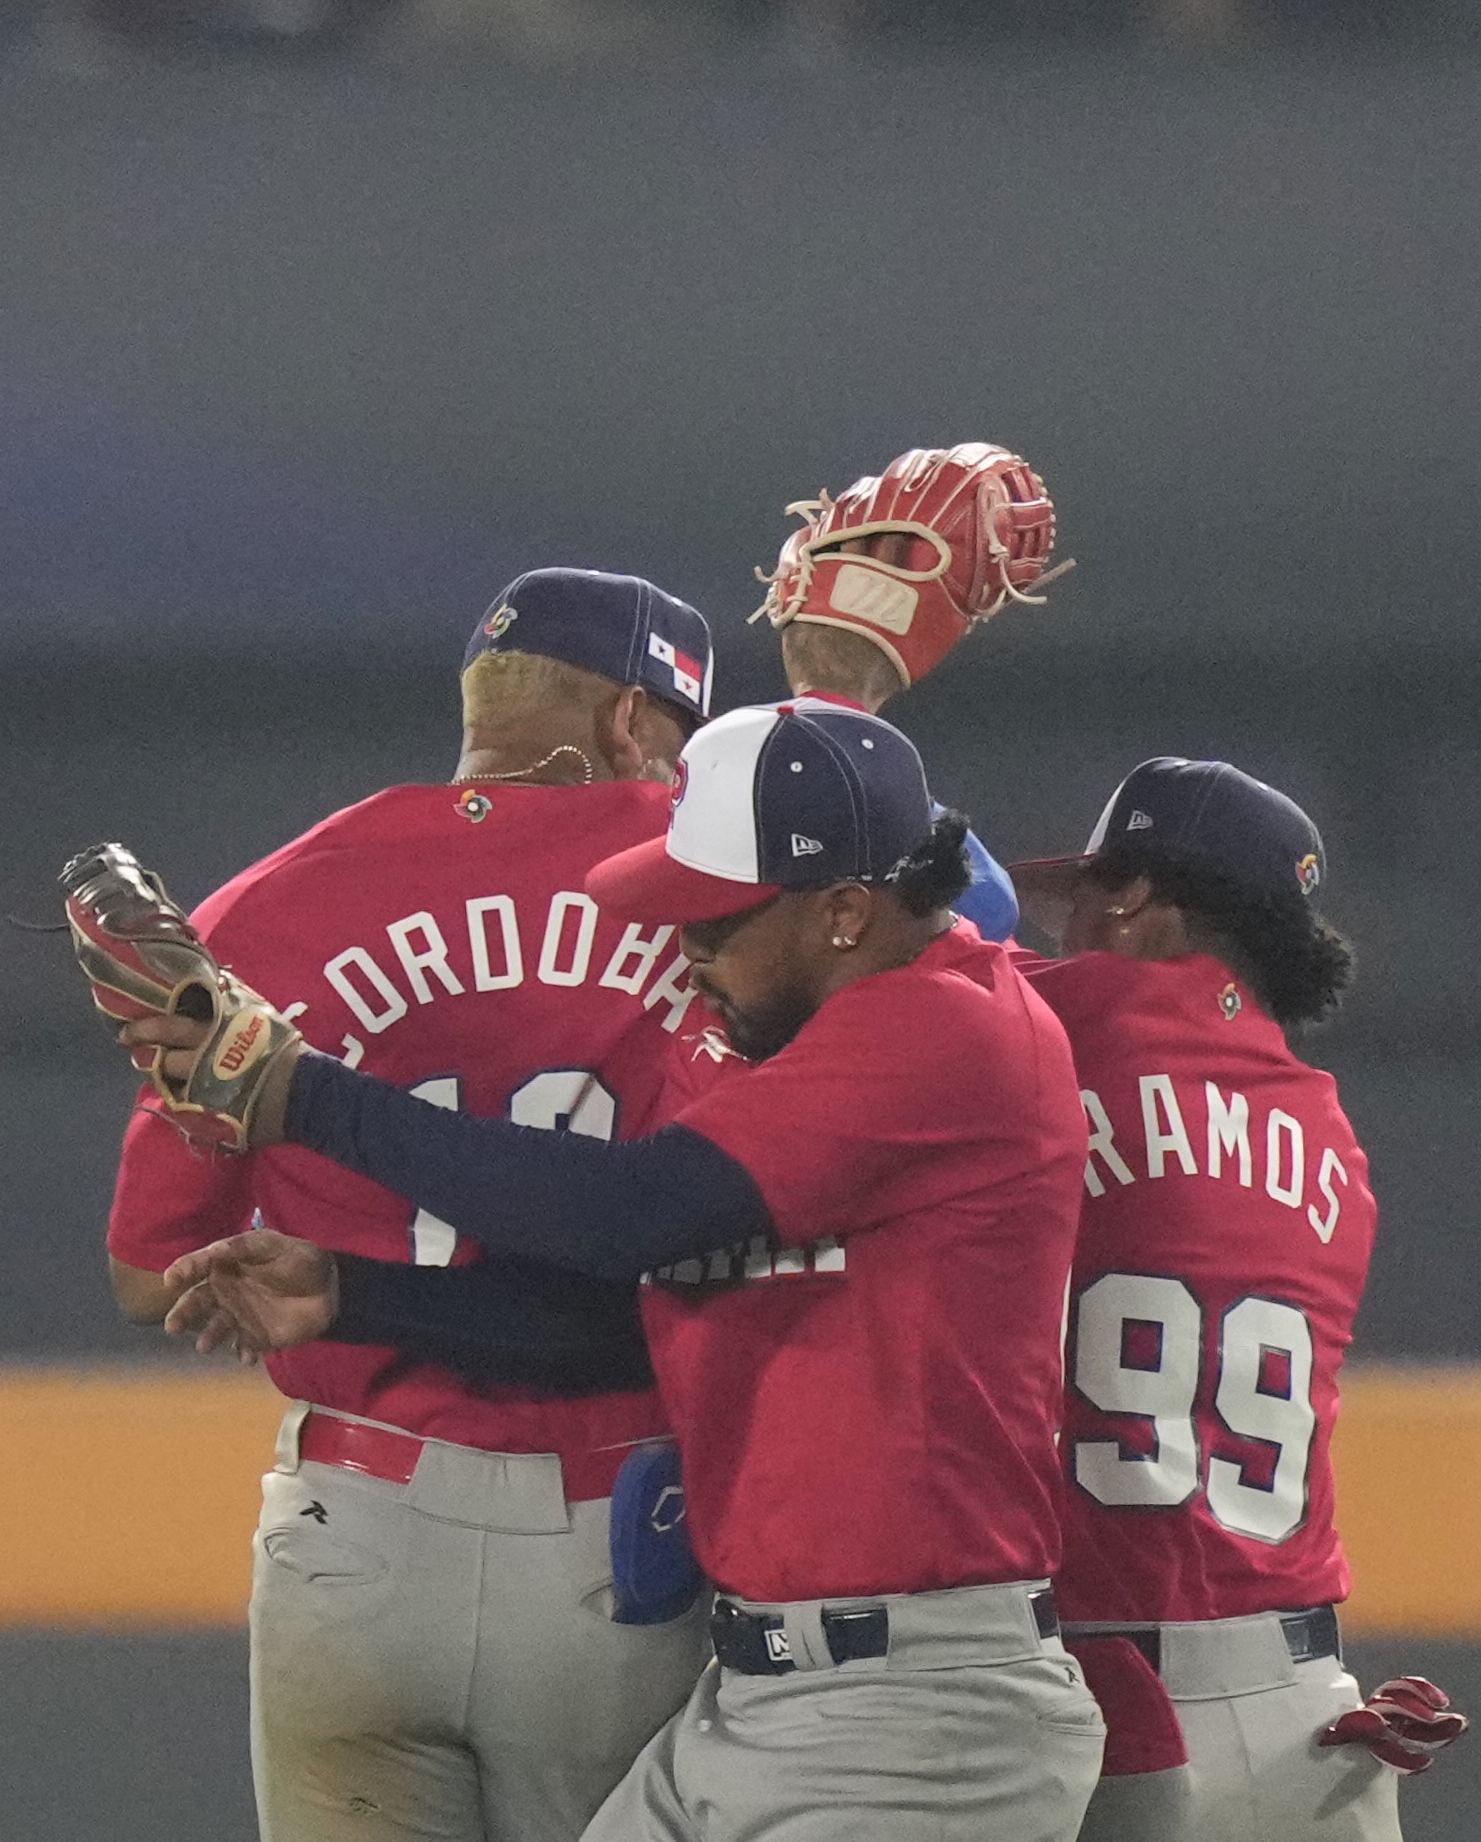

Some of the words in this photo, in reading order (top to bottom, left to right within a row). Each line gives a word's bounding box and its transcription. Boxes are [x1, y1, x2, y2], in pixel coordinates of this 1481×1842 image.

[219, 1015, 264, 1072] Wilson
[1080, 1074, 1347, 1244] RAMOS
[1071, 1272, 1317, 1543] 99
